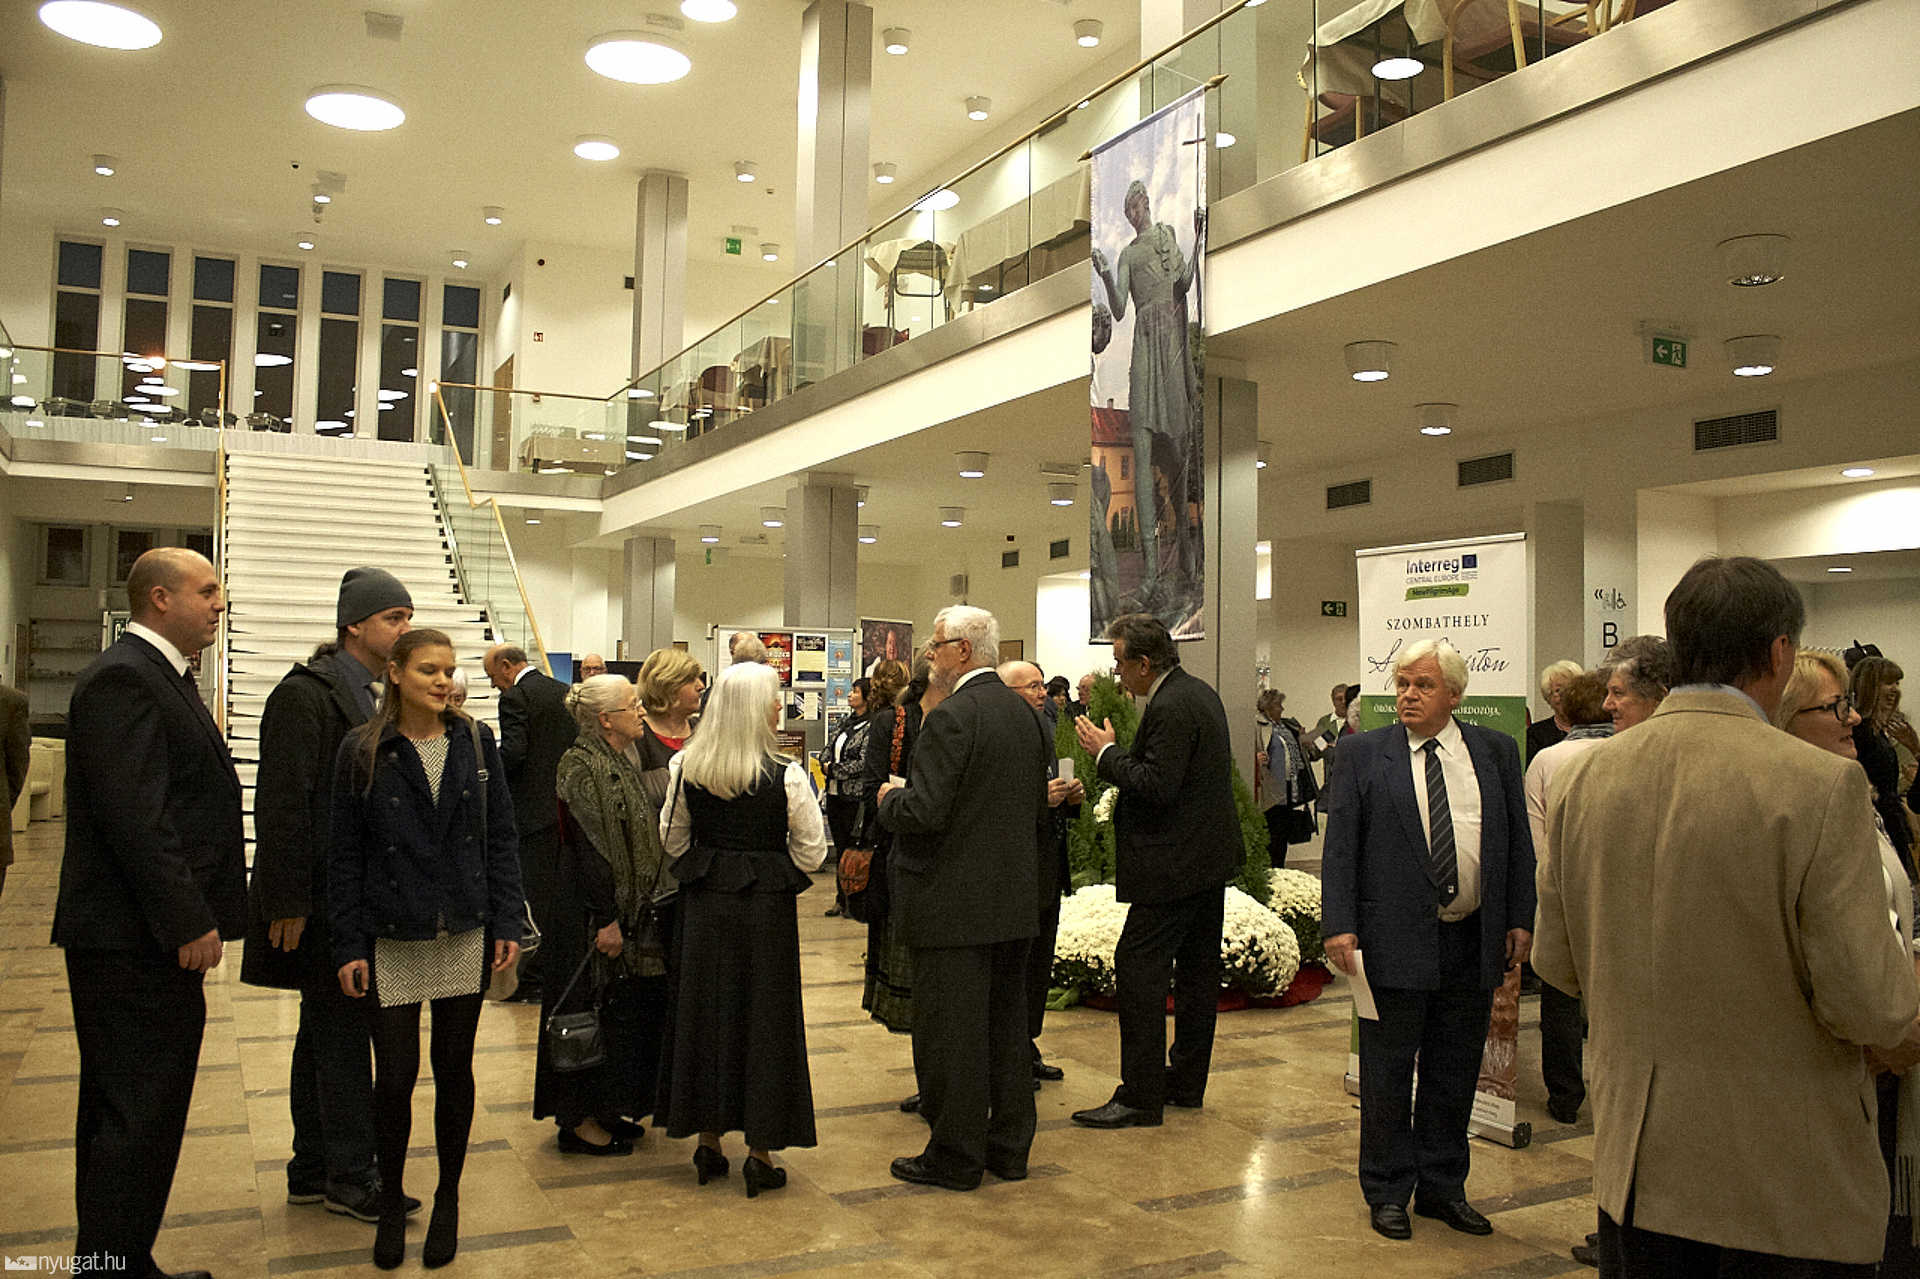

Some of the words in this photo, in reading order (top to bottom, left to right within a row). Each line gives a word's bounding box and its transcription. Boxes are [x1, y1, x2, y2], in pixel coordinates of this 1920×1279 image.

[1406, 558, 1460, 575] Interreg
[1406, 576, 1433, 585] CENTRAL
[1434, 573, 1460, 583] EUROPE
[1386, 614, 1490, 631] SZOMBATHELY
[1602, 621, 1619, 649] B
